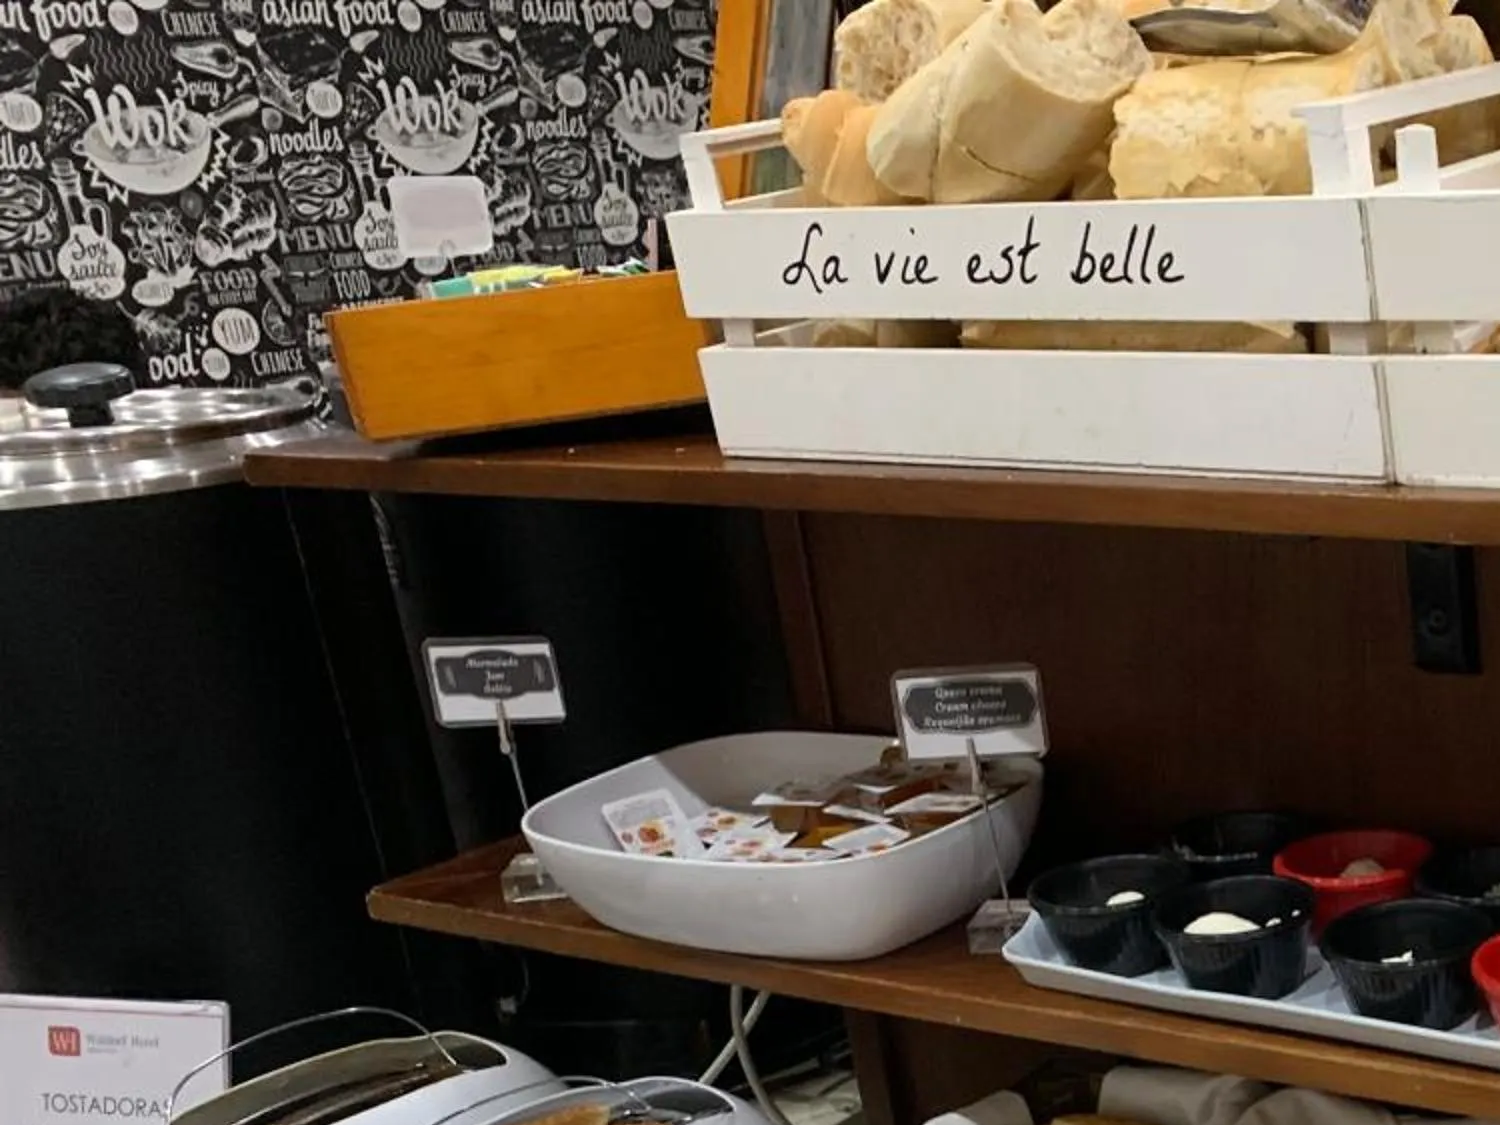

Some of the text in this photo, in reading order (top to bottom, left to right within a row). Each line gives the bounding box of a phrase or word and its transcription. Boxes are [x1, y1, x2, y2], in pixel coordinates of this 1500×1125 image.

[30, 0, 105, 42] food
[263, 0, 394, 38] asian food
[376, 76, 464, 136] Wok
[614, 68, 687, 121] Wok
[84, 84, 191, 149] Wok
[526, 107, 587, 141] noodles
[269, 117, 345, 157] noodles
[532, 202, 594, 229] MENU
[278, 223, 353, 253] MENU
[783, 216, 1186, 293] La vie est belle
[0, 249, 56, 281] ENU
[199, 267, 258, 293] FOOD
[149, 332, 200, 381] ood
